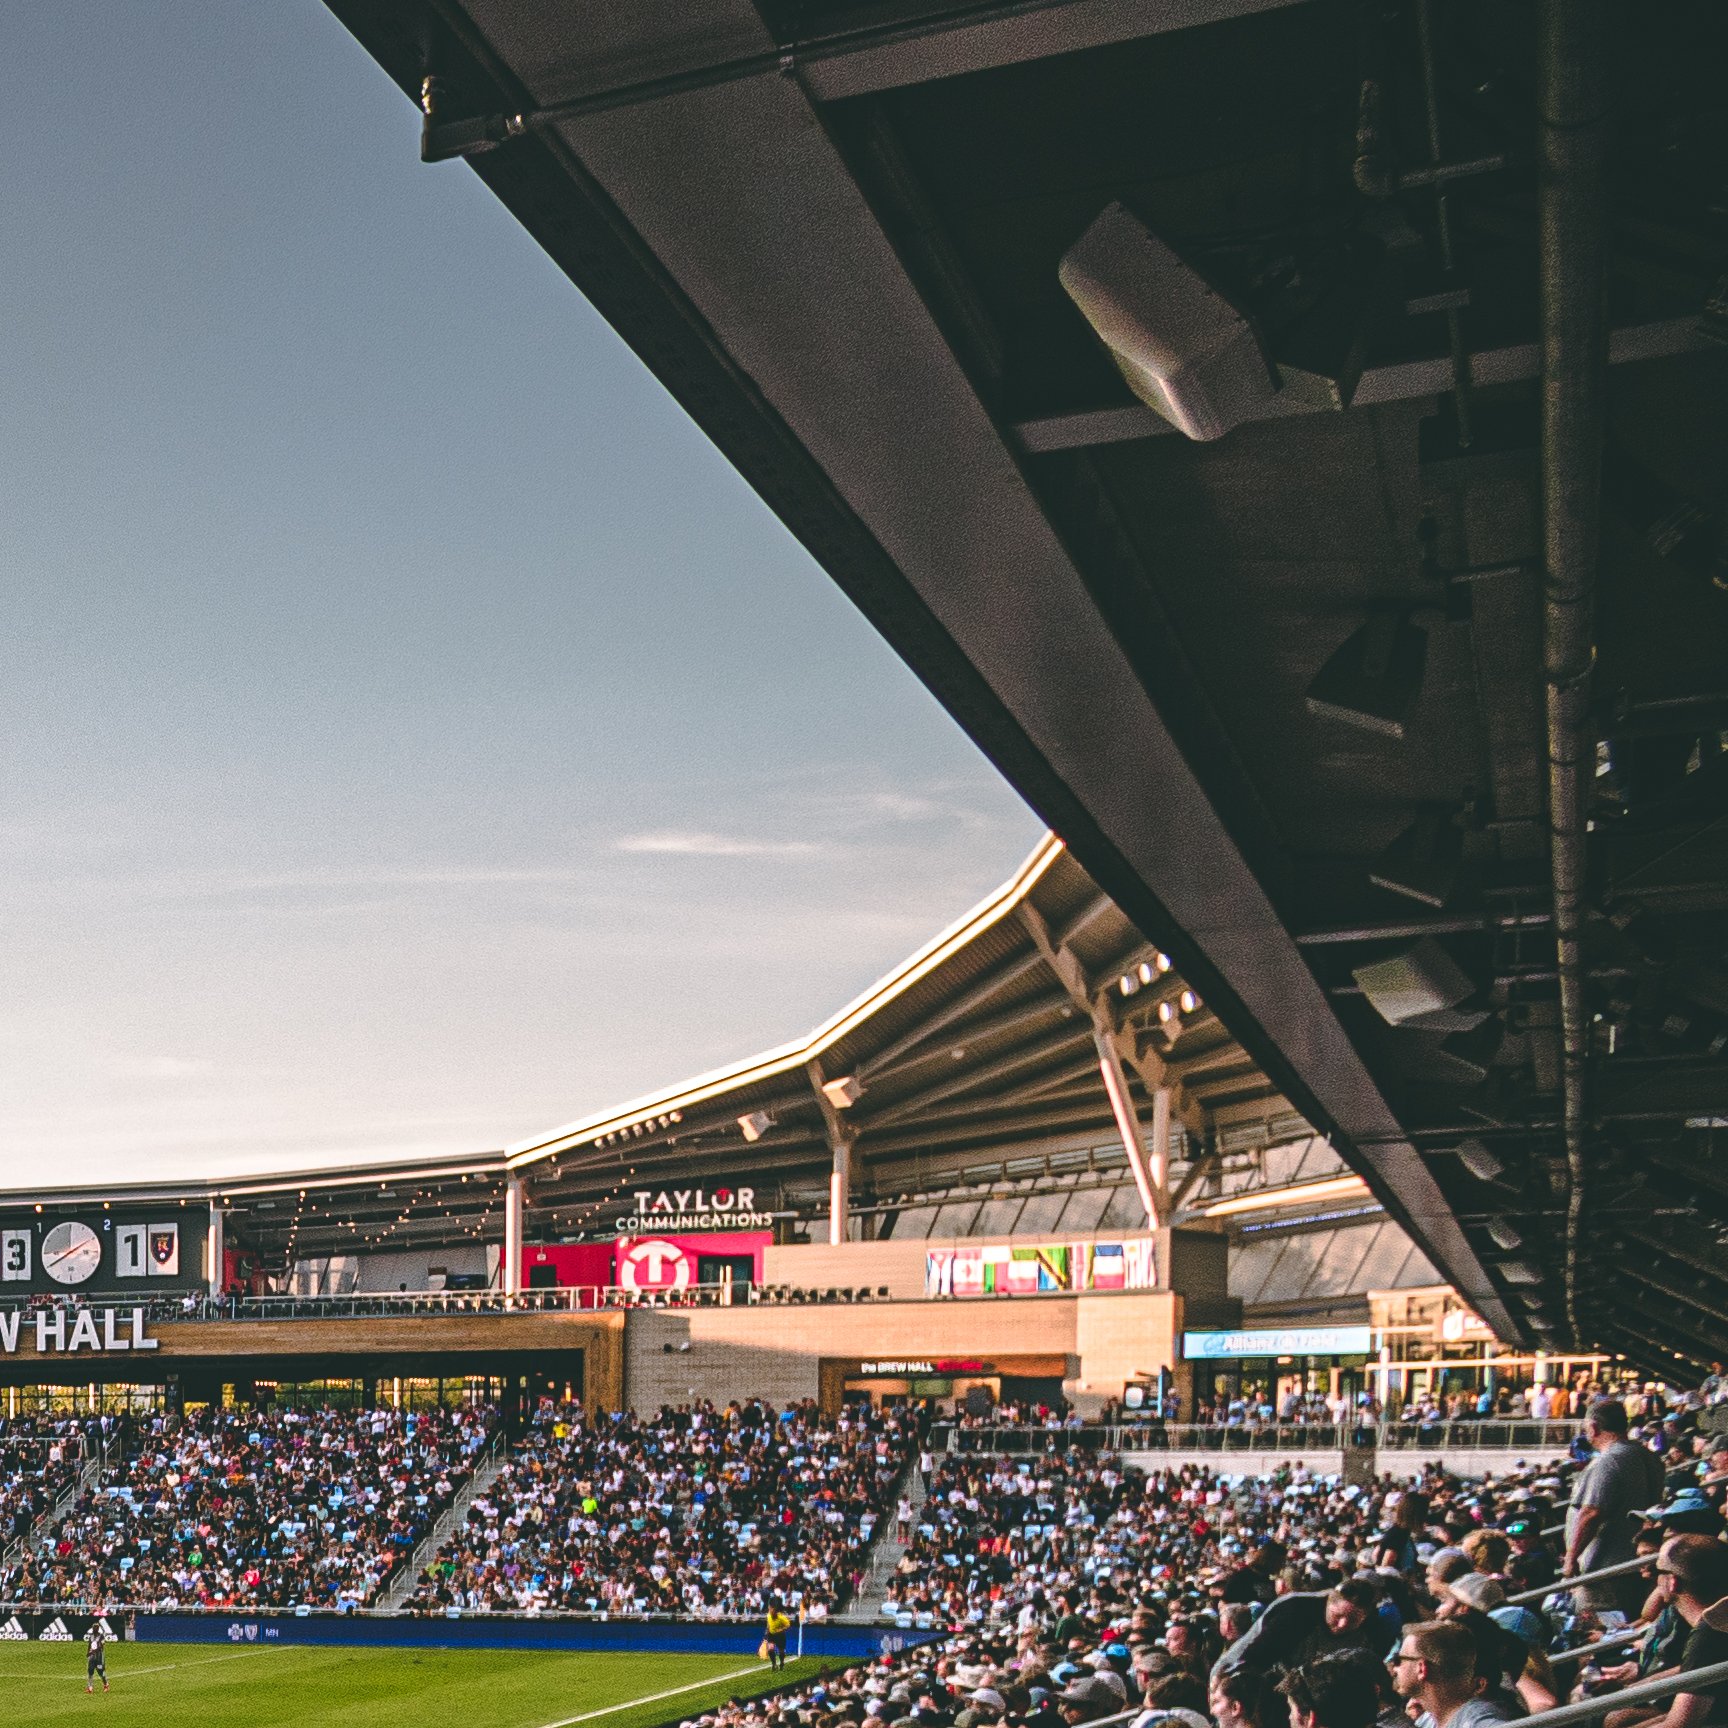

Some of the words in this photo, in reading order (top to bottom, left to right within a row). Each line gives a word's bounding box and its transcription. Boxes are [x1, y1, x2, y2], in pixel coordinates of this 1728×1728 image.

[633, 1187, 755, 1214] TAYLOR
[103, 1219, 111, 1231] 2
[615, 1211, 773, 1231] COMMUNICATIONS
[7, 1238, 26, 1271] 3
[124, 1233, 139, 1267] 1
[36, 1308, 158, 1351] HALL
[39, 1632, 73, 1641] adidas
